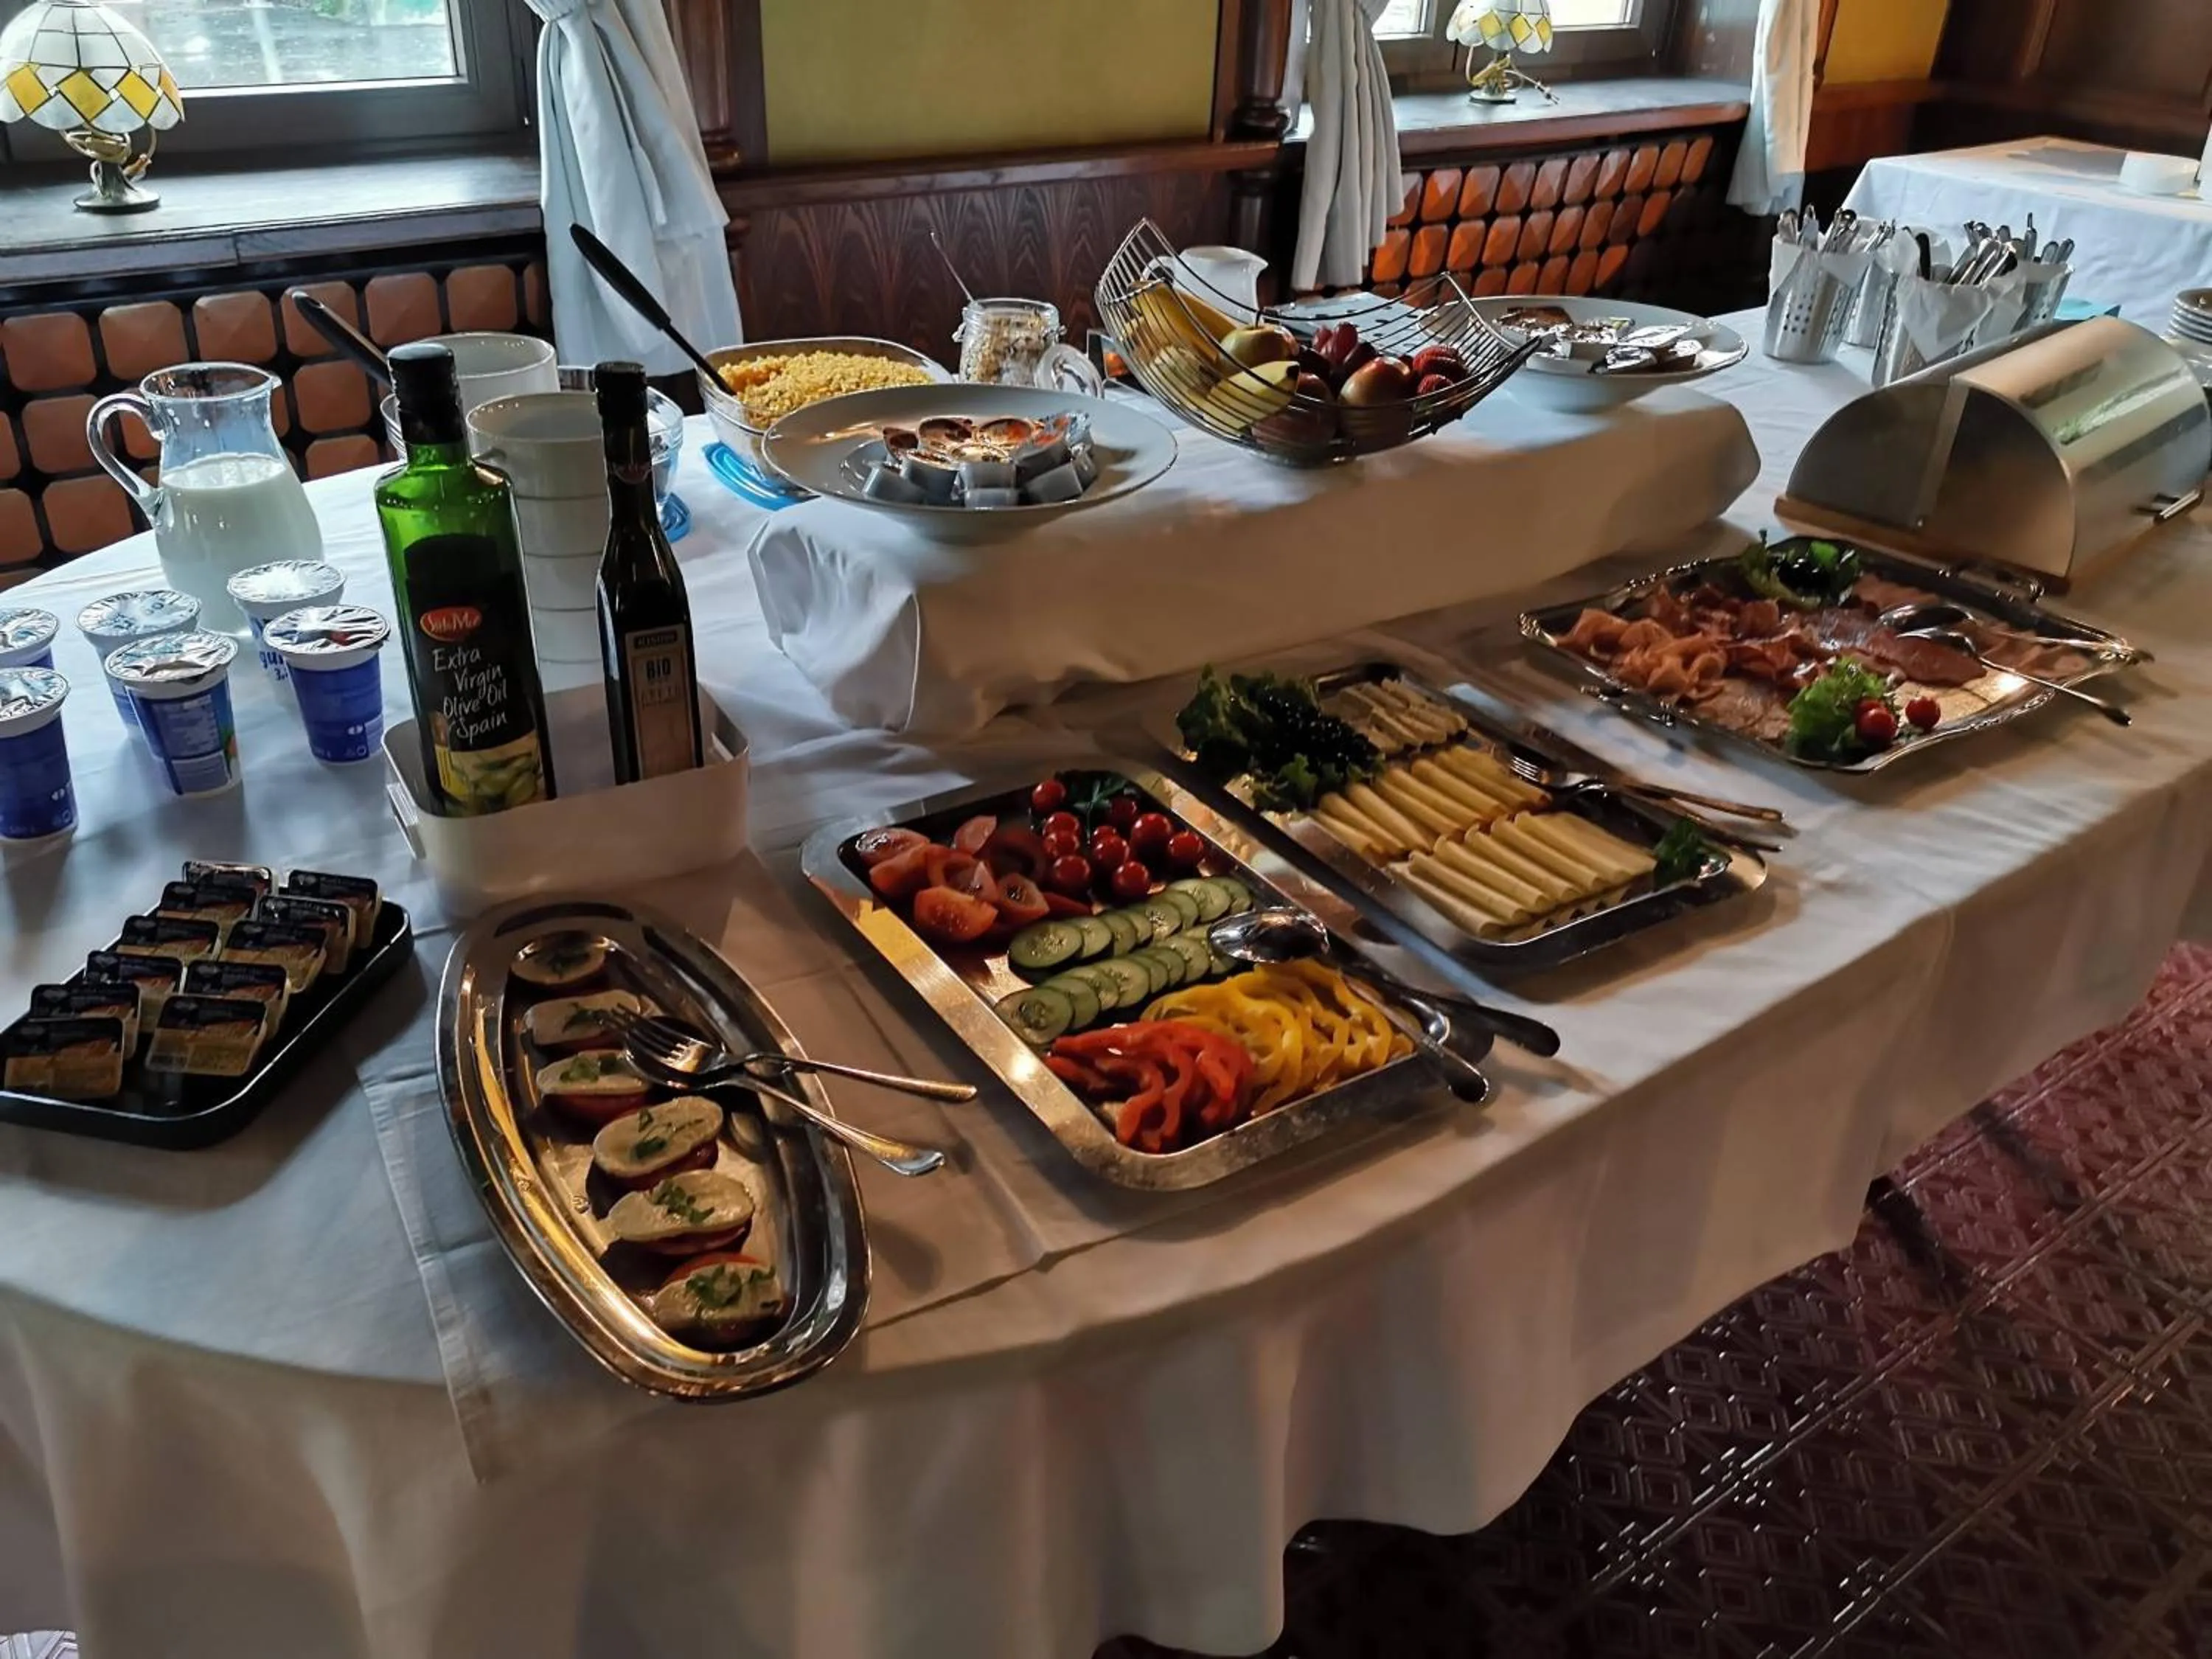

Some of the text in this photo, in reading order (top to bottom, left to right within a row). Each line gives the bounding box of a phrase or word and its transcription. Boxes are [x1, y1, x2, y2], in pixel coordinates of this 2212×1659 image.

[432, 646, 481, 672] Extra
[443, 678, 507, 720] Olive Oil
[454, 663, 502, 700] Virgin
[456, 711, 507, 745] Spain
